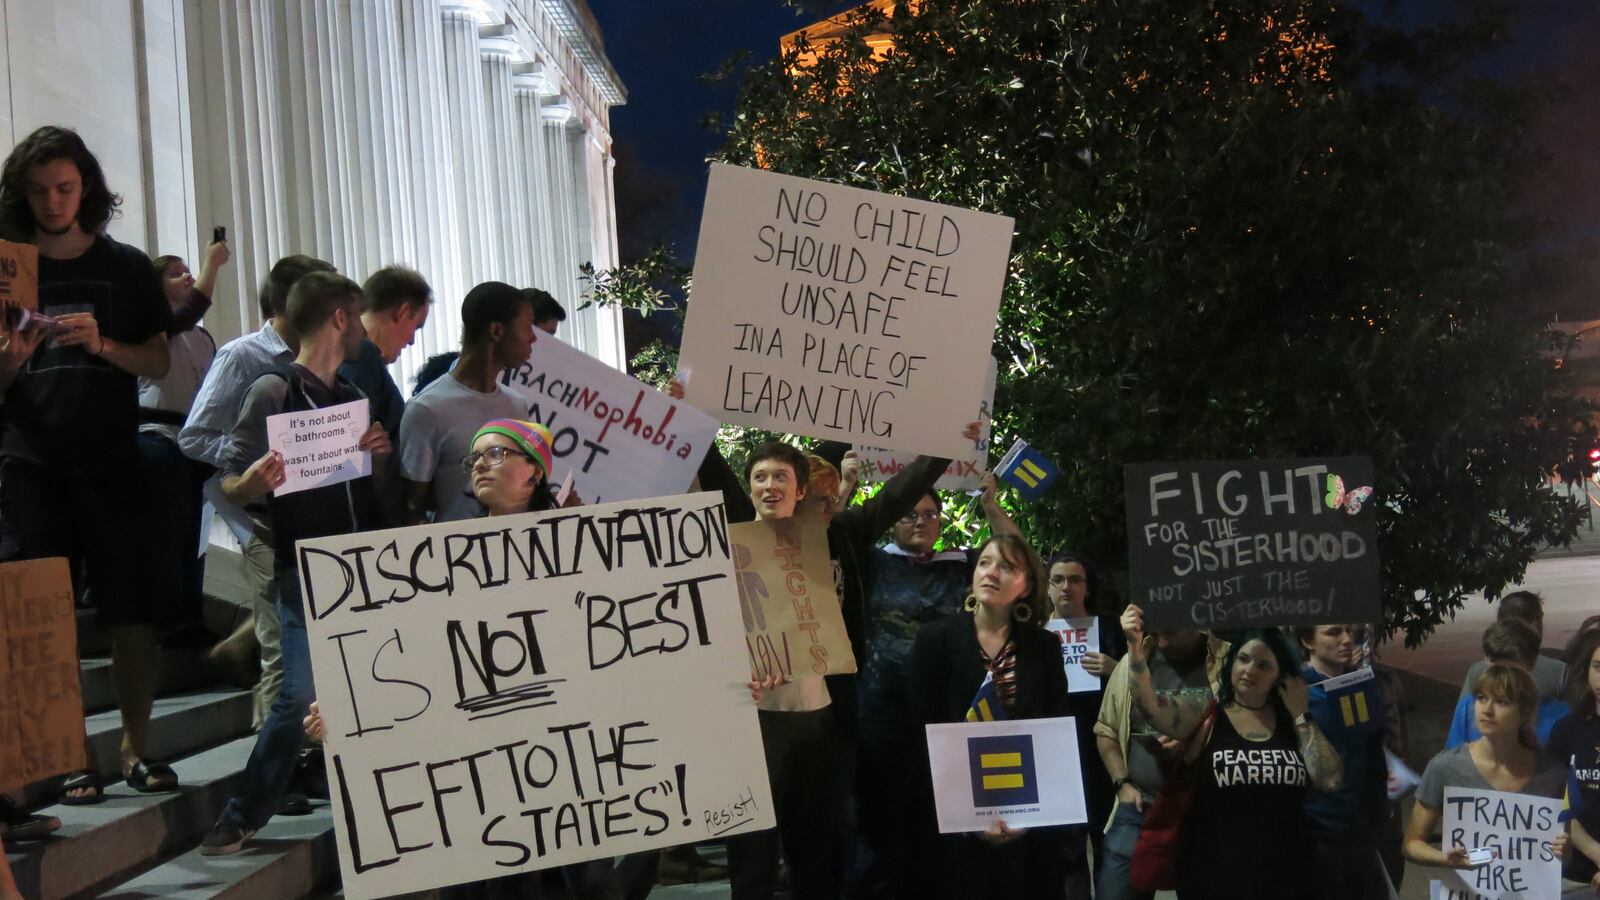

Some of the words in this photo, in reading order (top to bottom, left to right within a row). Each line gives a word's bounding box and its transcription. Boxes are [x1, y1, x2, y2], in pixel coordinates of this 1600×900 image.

[776, 188, 828, 227] NO
[853, 202, 960, 257] CHILD
[754, 225, 867, 284] SHOULD
[880, 255, 958, 297] FEEL
[781, 282, 906, 338] UNSAFE
[734, 324, 763, 353] IN
[766, 328, 783, 359] A
[802, 332, 880, 380] PLACE
[886, 352, 927, 389] OF
[290, 419, 306, 429] It's
[309, 416, 325, 426] not
[327, 410, 351, 424] about
[723, 365, 895, 438] LEARNING
[284, 453, 315, 466] wasn't
[318, 448, 342, 461] about
[344, 443, 364, 454] wate
[527, 403, 609, 473] NOT
[300, 463, 345, 478] fountains.
[1150, 465, 1327, 516] FIGHT
[1144, 521, 1188, 546] FOR
[1202, 517, 1241, 540] THE
[300, 504, 730, 620] DISCRIMINATION
[1172, 530, 1366, 577] SISTERHOOD
[1149, 584, 1185, 601] NOT
[1202, 575, 1244, 600] JUST
[1262, 570, 1310, 592] THE
[1191, 588, 1335, 625] CIS-TERHOOD!
[1071, 645, 1087, 654] TO
[328, 629, 431, 737] IS
[447, 610, 549, 700] NOT
[1213, 750, 1304, 768] PEACEFUL
[1213, 765, 1306, 788] WARRIOR
[333, 749, 493, 873] LEFT
[494, 740, 557, 803] TO
[548, 721, 659, 799] THE
[1447, 797, 1552, 831] TRANS
[1452, 828, 1555, 862] RIGHTS
[1476, 863, 1528, 893] ARE
